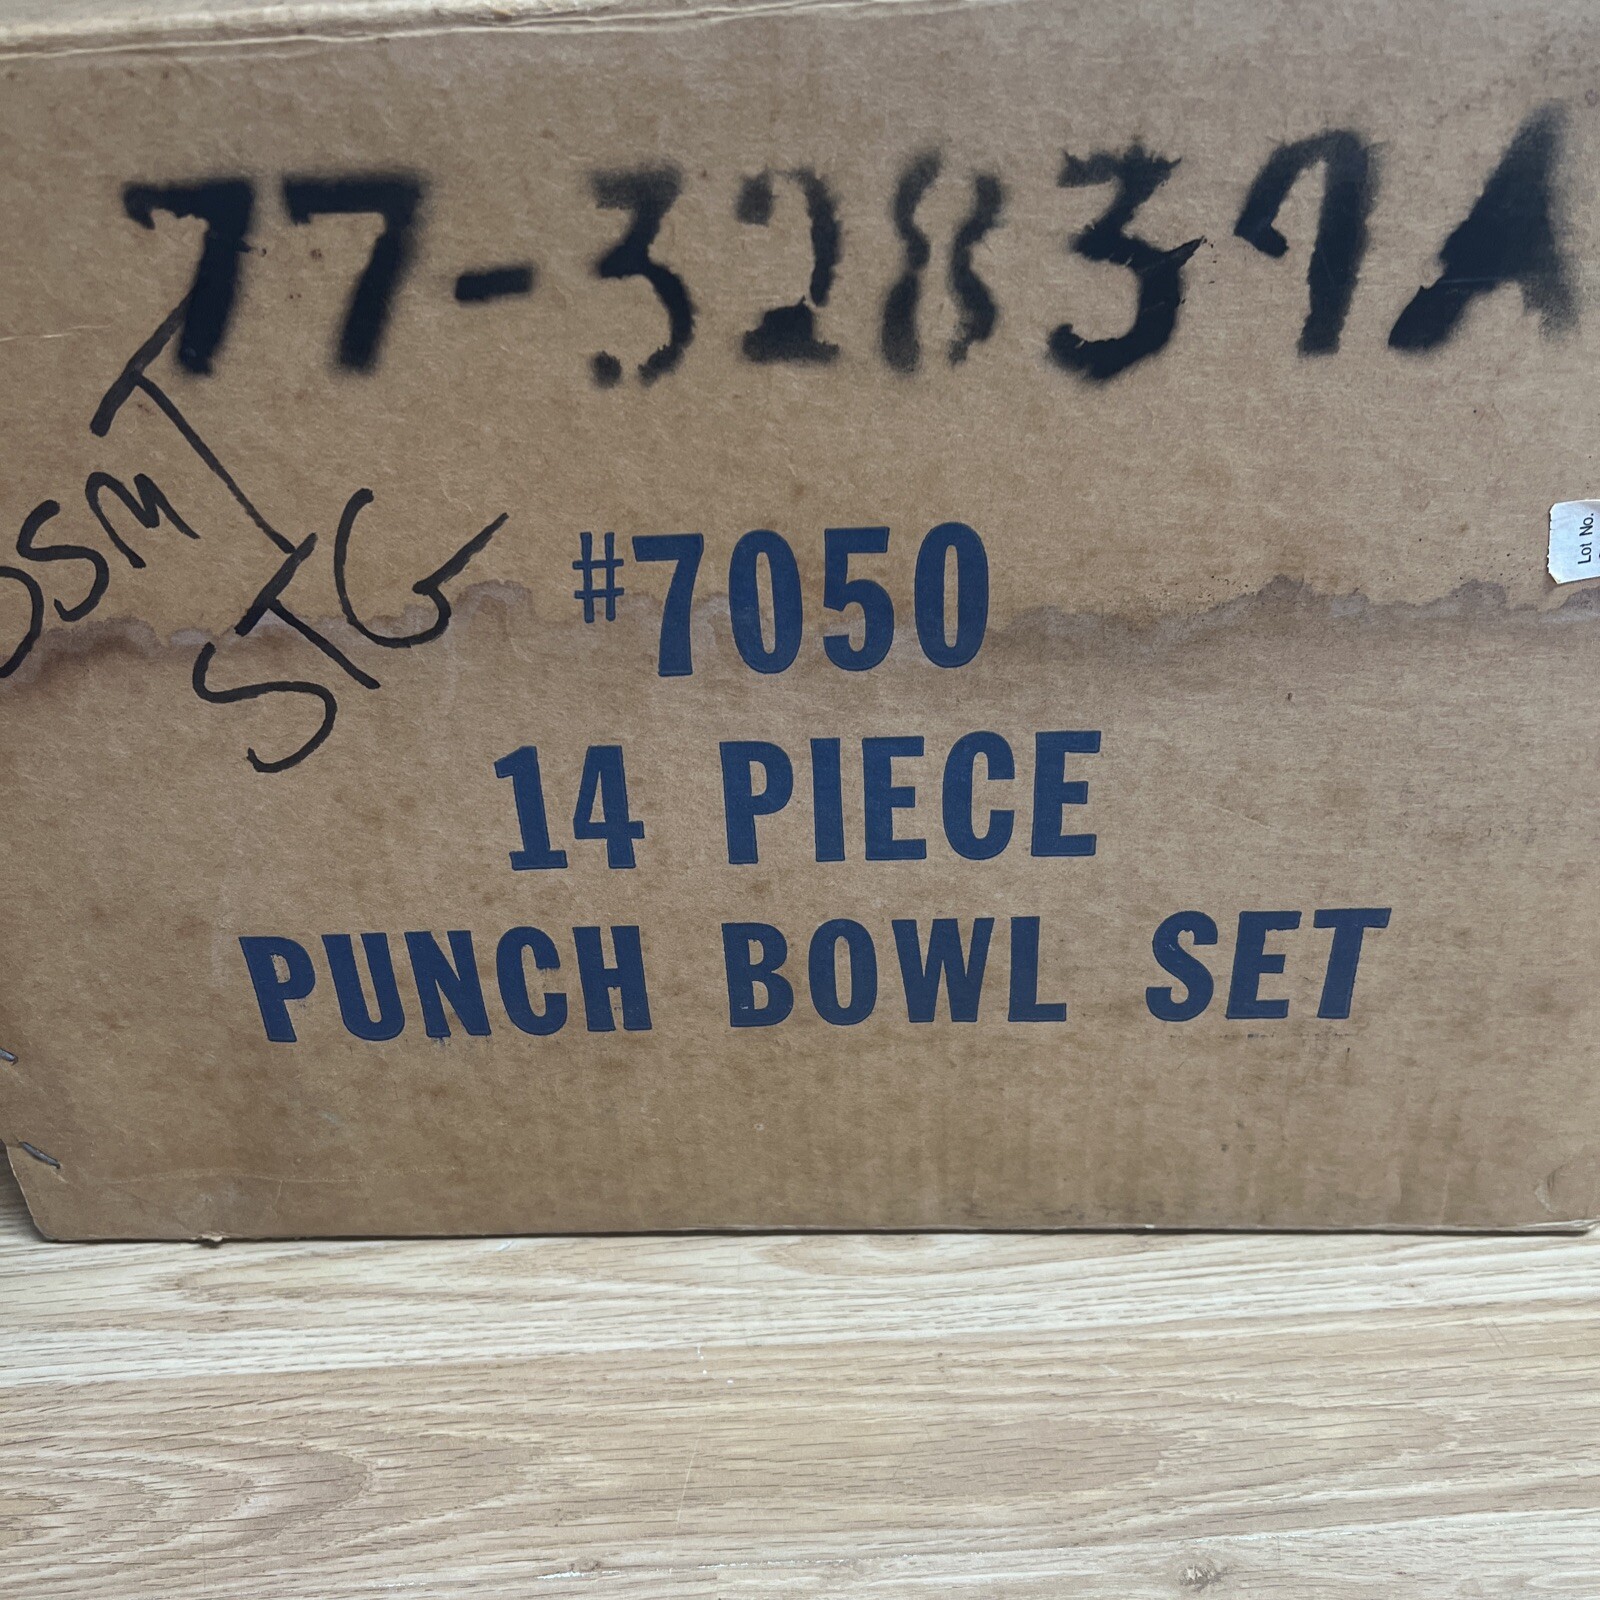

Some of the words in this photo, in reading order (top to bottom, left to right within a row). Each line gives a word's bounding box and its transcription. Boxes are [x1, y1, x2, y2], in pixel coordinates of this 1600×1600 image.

[1578, 542, 1592, 565] Lot
[1579, 513, 1594, 537] No.
[572, 522, 989, 677] #7050
[494, 745, 645, 871] 14
[719, 730, 1102, 865] PIECE
[239, 925, 652, 1043] PUNCH
[722, 916, 1067, 1028] BOWL
[1146, 908, 1392, 1022] SET
